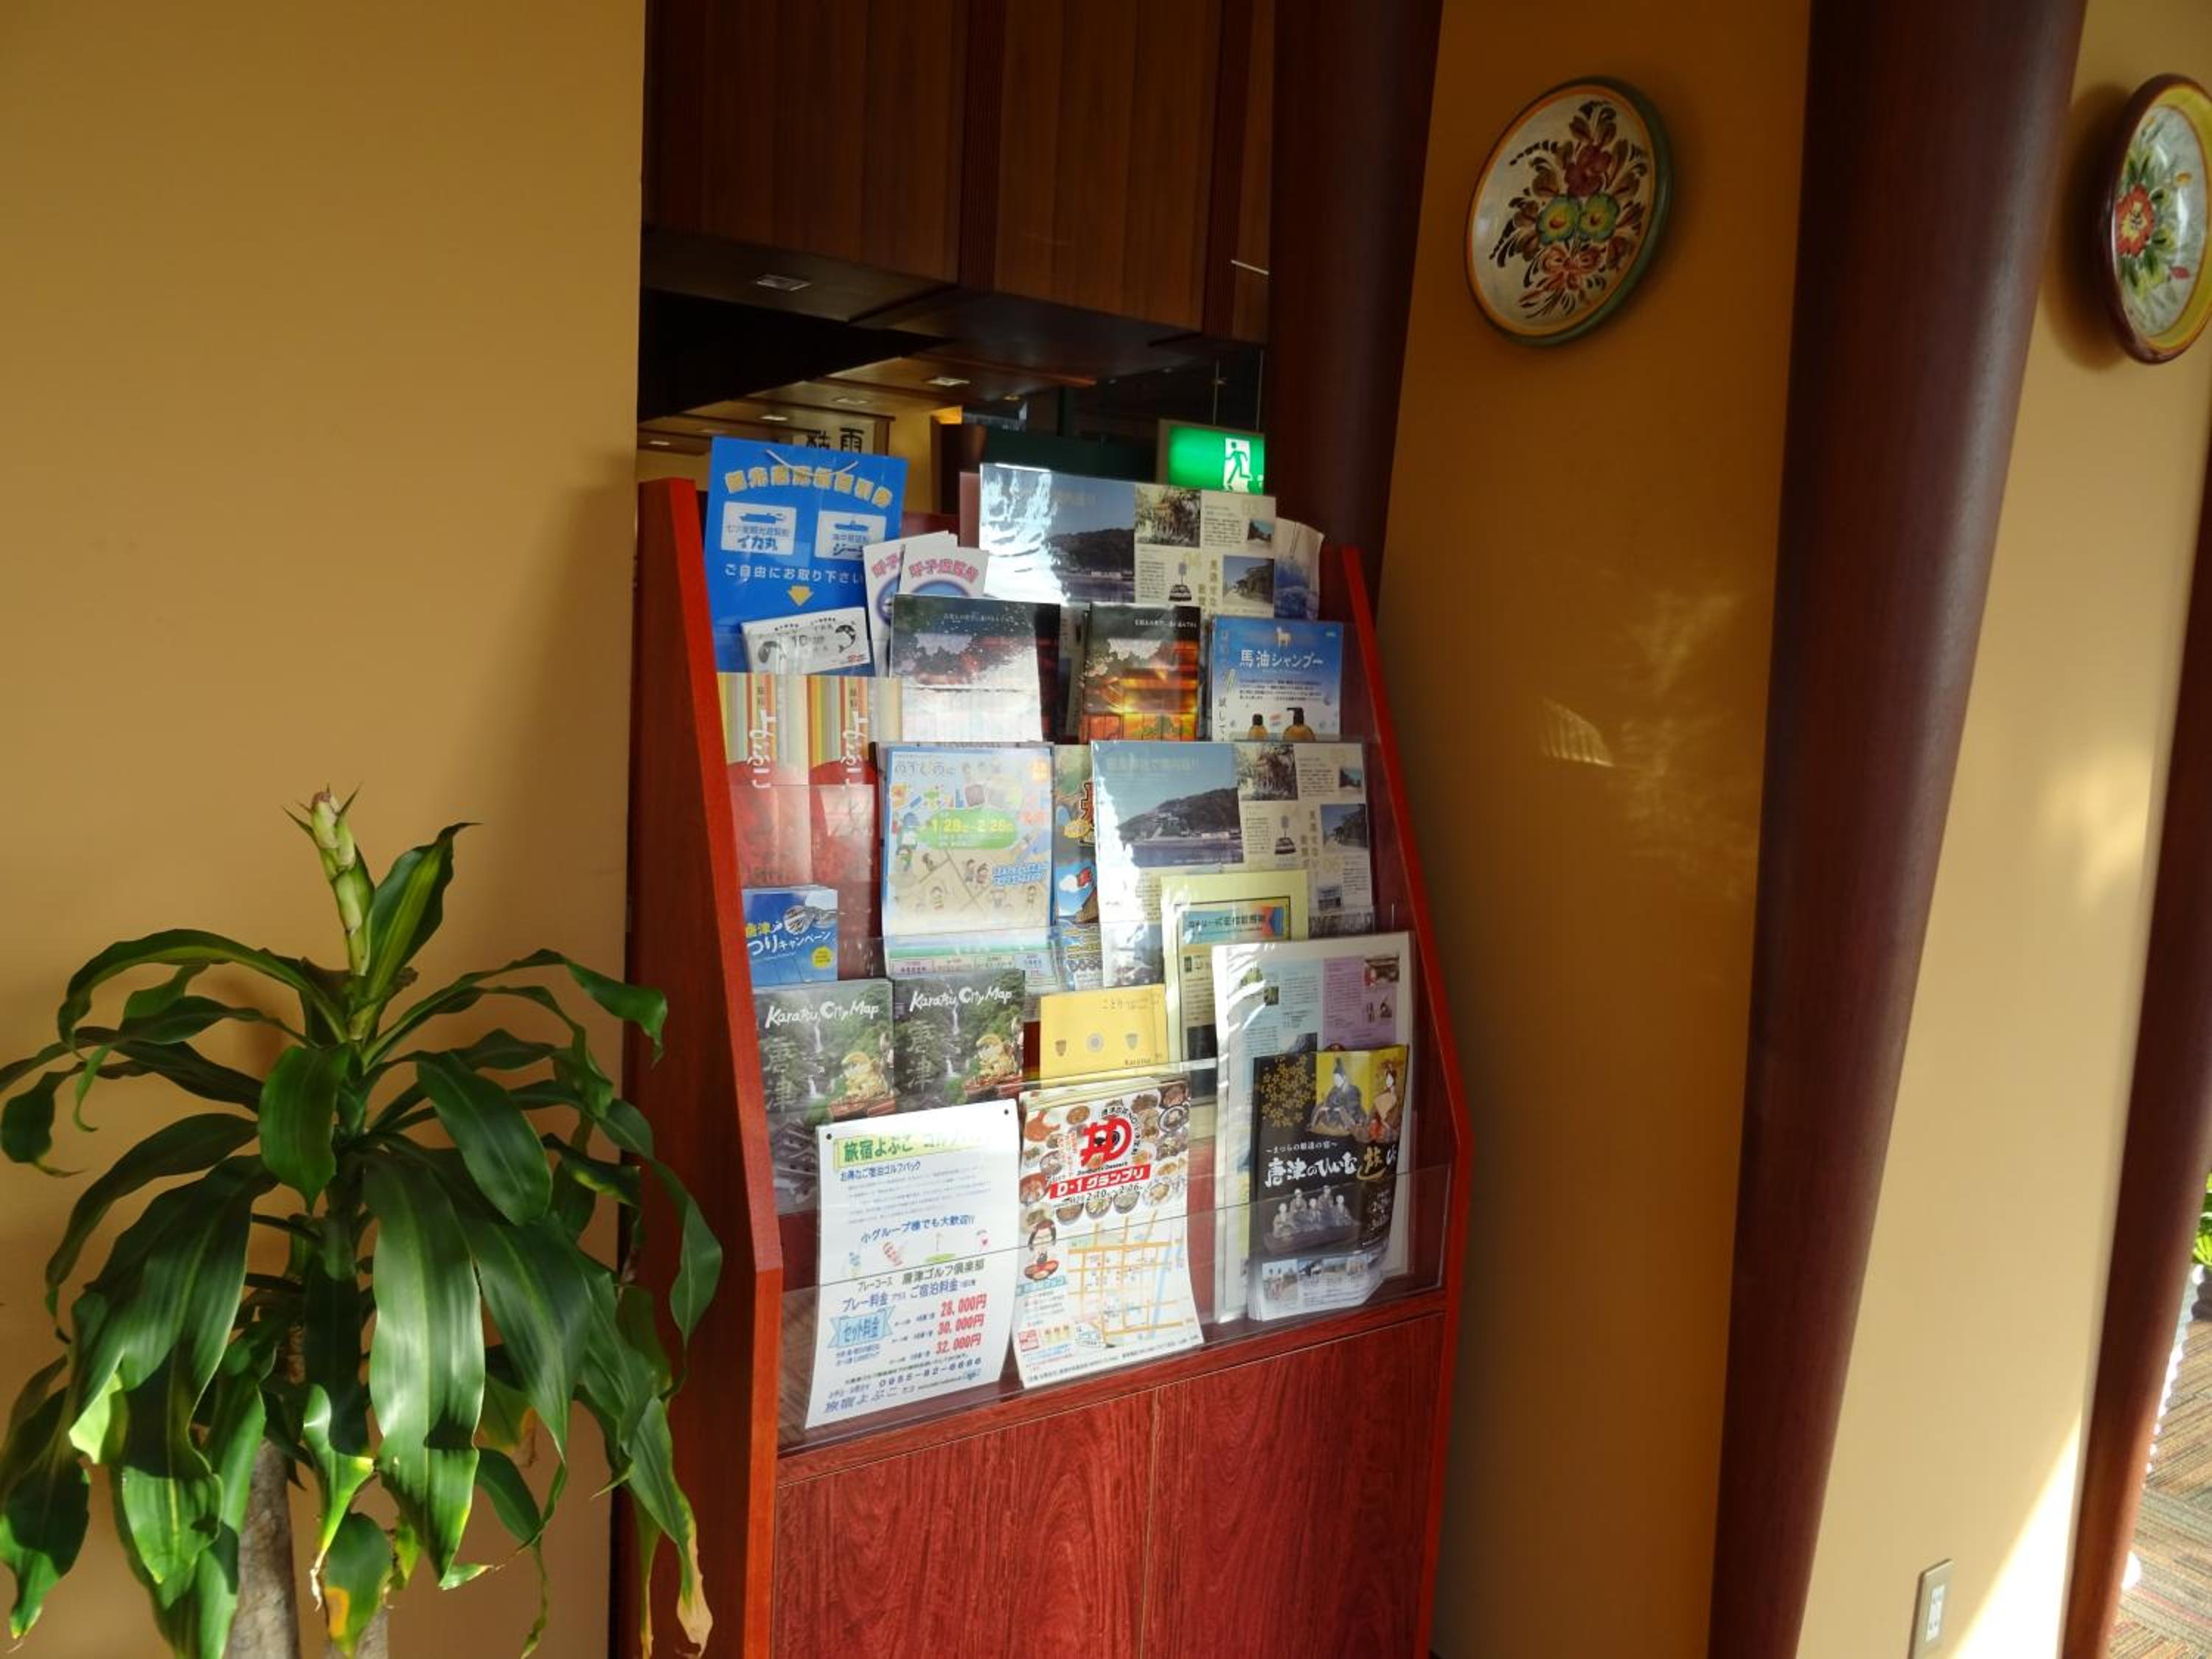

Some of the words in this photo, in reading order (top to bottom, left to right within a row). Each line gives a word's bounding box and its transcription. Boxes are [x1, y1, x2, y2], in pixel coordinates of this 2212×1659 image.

[1239, 649, 1324, 669] 馬油シャンプー
[747, 931, 832, 956] つりキャンペーン
[984, 986, 1013, 1004] Map
[849, 1000, 880, 1020] Map
